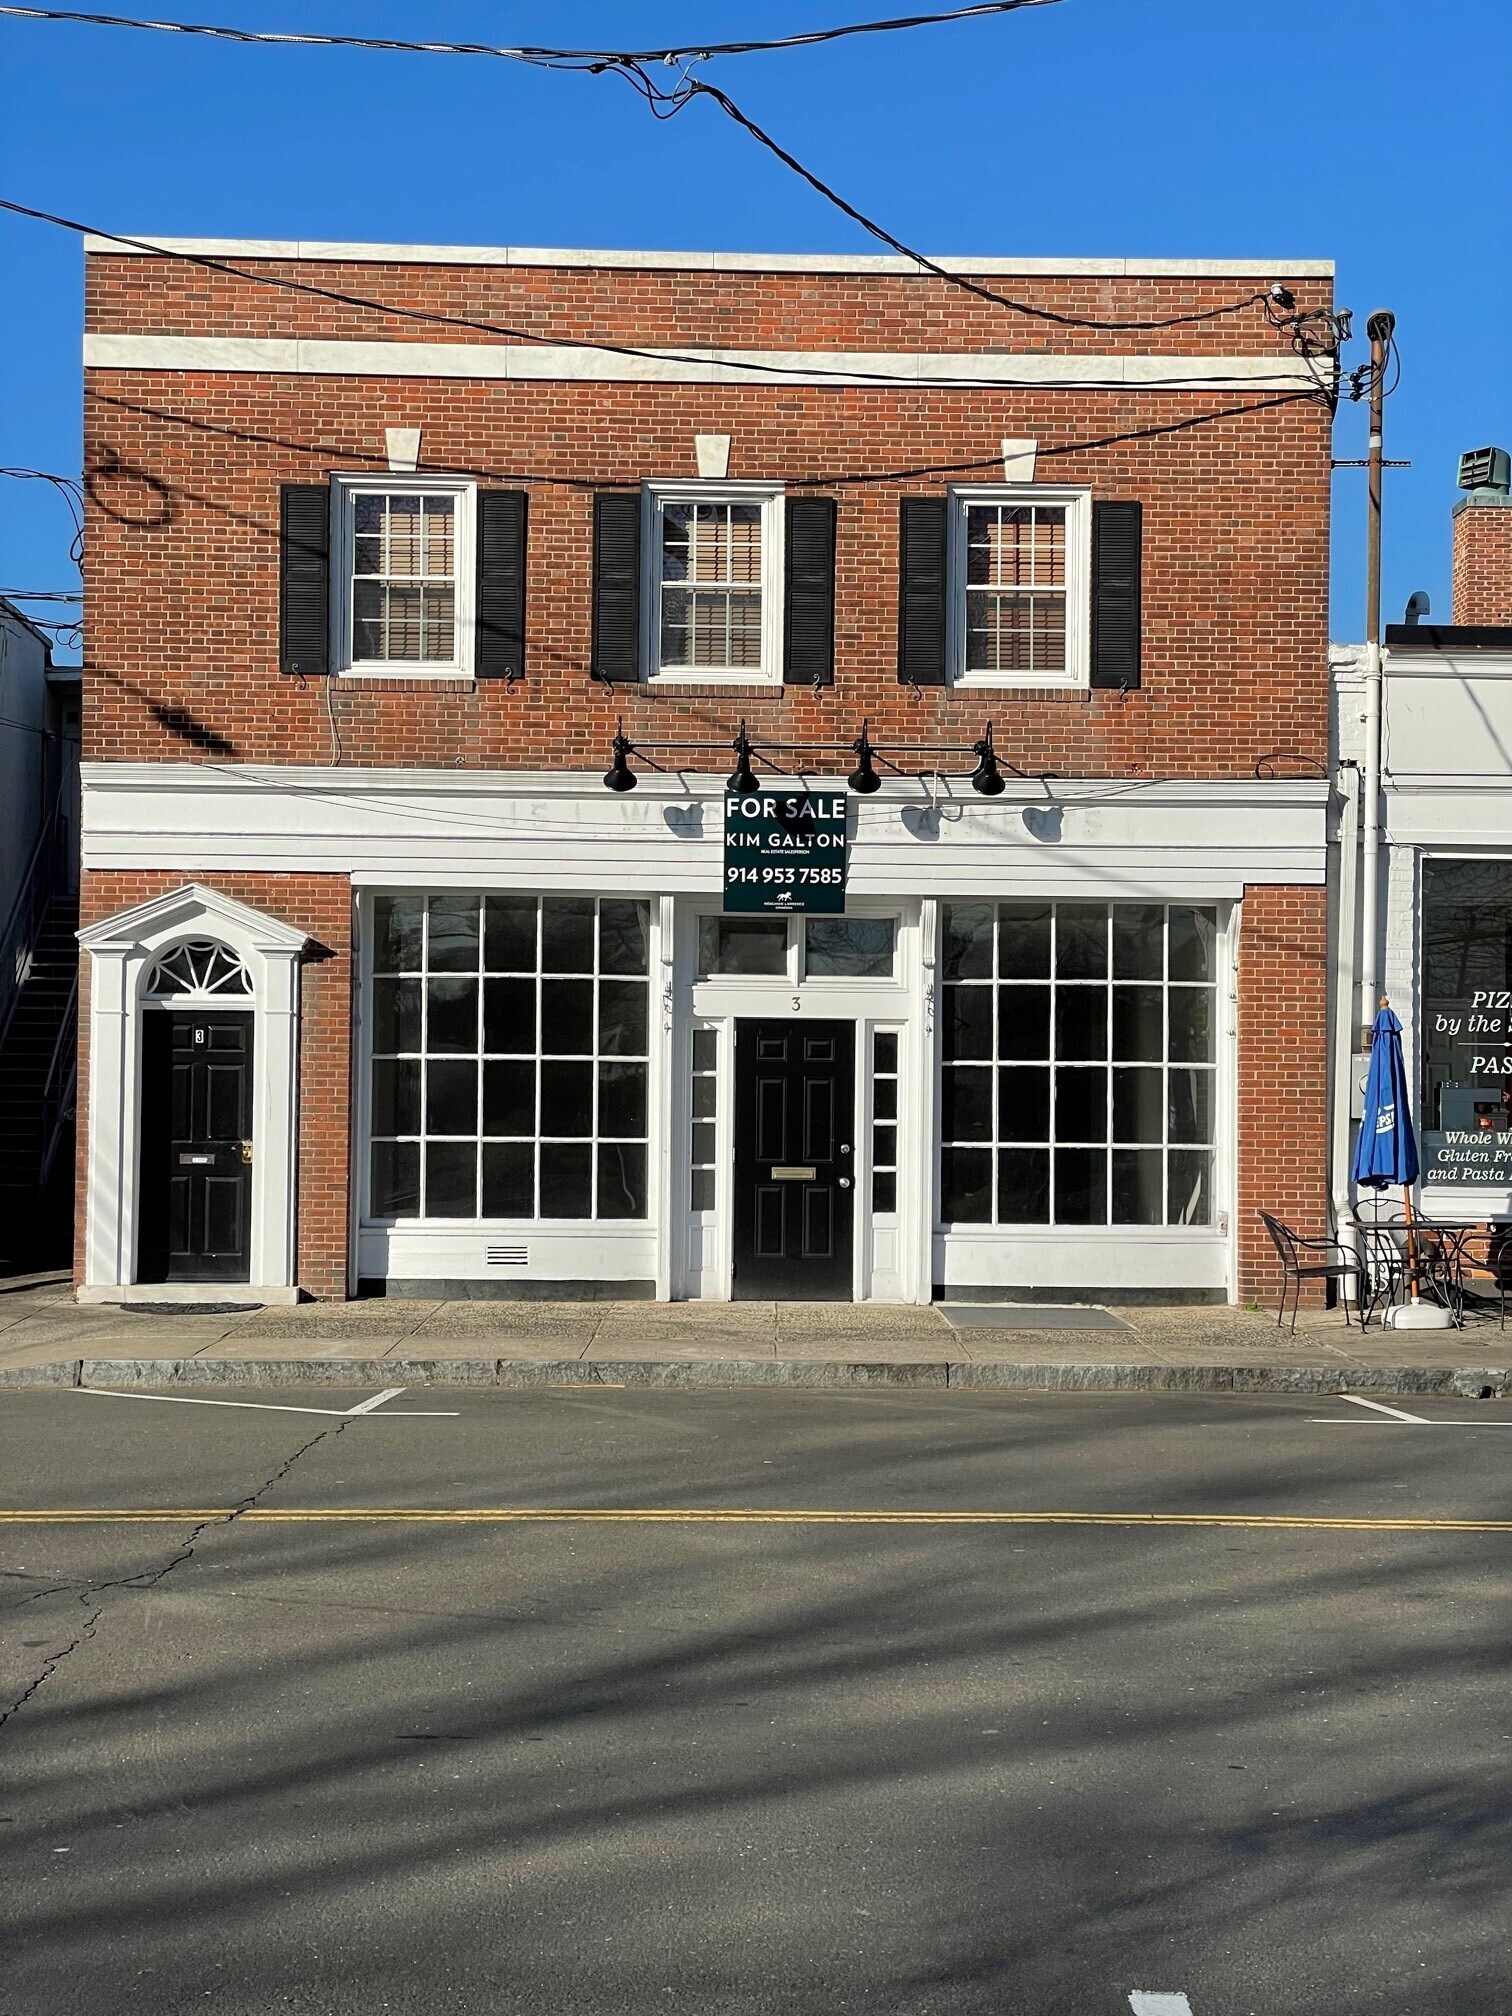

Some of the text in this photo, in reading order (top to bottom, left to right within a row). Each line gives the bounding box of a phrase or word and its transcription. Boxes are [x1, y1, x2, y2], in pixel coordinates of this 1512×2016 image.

[727, 798, 845, 819] FOR SALE
[726, 833, 844, 848] KIM GALTON
[727, 867, 842, 884] 914 953 7585
[792, 996, 801, 1011] 3
[1471, 991, 1512, 1009] PIZ
[1435, 1014, 1462, 1036] by
[1467, 1014, 1501, 1033] the
[197, 1031, 203, 1042] 3
[1445, 1131, 1512, 1145] Whole W
[1438, 1149, 1512, 1163] Gluten Fr
[1427, 1167, 1458, 1181] and
[1462, 1167, 1505, 1181] Pasta
